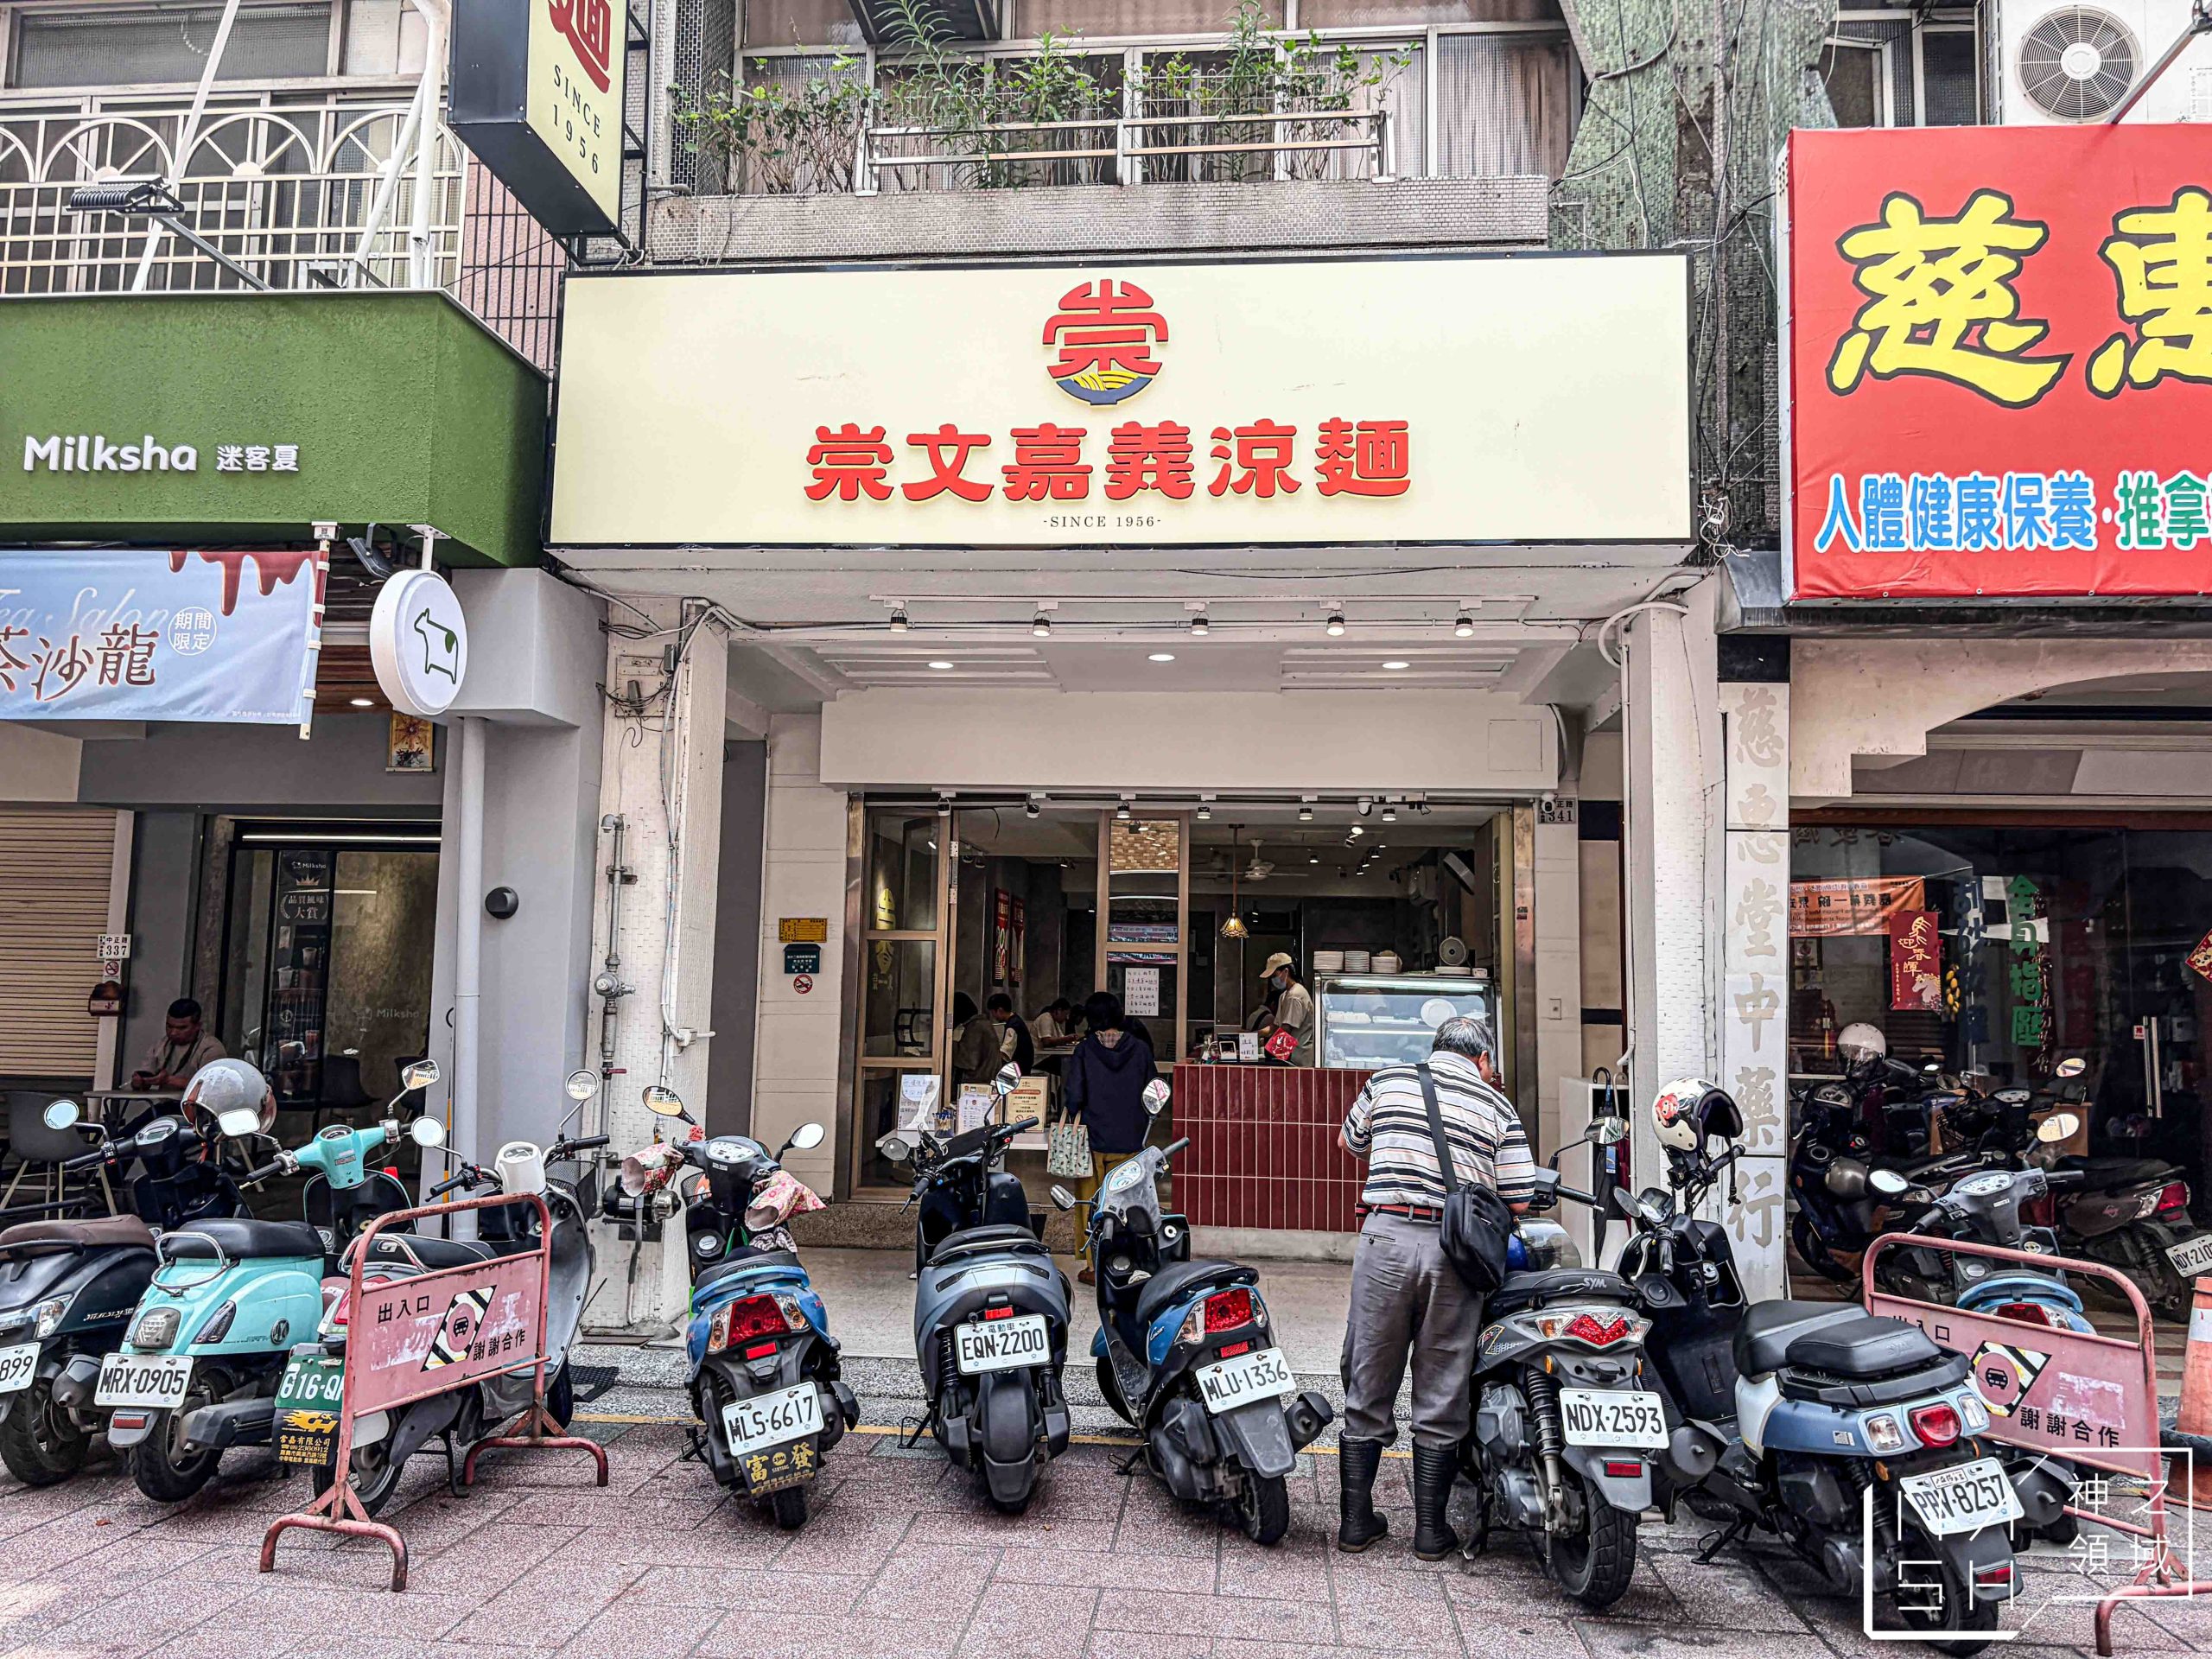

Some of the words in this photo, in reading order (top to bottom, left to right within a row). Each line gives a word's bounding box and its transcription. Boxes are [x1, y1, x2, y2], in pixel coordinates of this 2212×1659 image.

[553, 64, 601, 138] SINCE
[553, 104, 598, 174] 1956
[23, 435, 197, 472] Milksha
[216, 444, 300, 473] 迷客夏
[804, 417, 1411, 502] 崇文嘉義涼麵
[1816, 472, 2212, 551] 人體健康保養·推拿
[175, 612, 211, 630] 期間
[174, 632, 209, 650] 限定
[1548, 810, 1573, 822] 341
[105, 944, 127, 956] 337
[1583, 1277, 1607, 1288] SYM
[378, 1296, 430, 1324] 出入口
[473, 1329, 526, 1362] 謝謝合作
[2021, 1407, 2120, 1448] 謝謝合作
[746, 1454, 769, 1483] 富
[790, 1441, 815, 1470] 發
